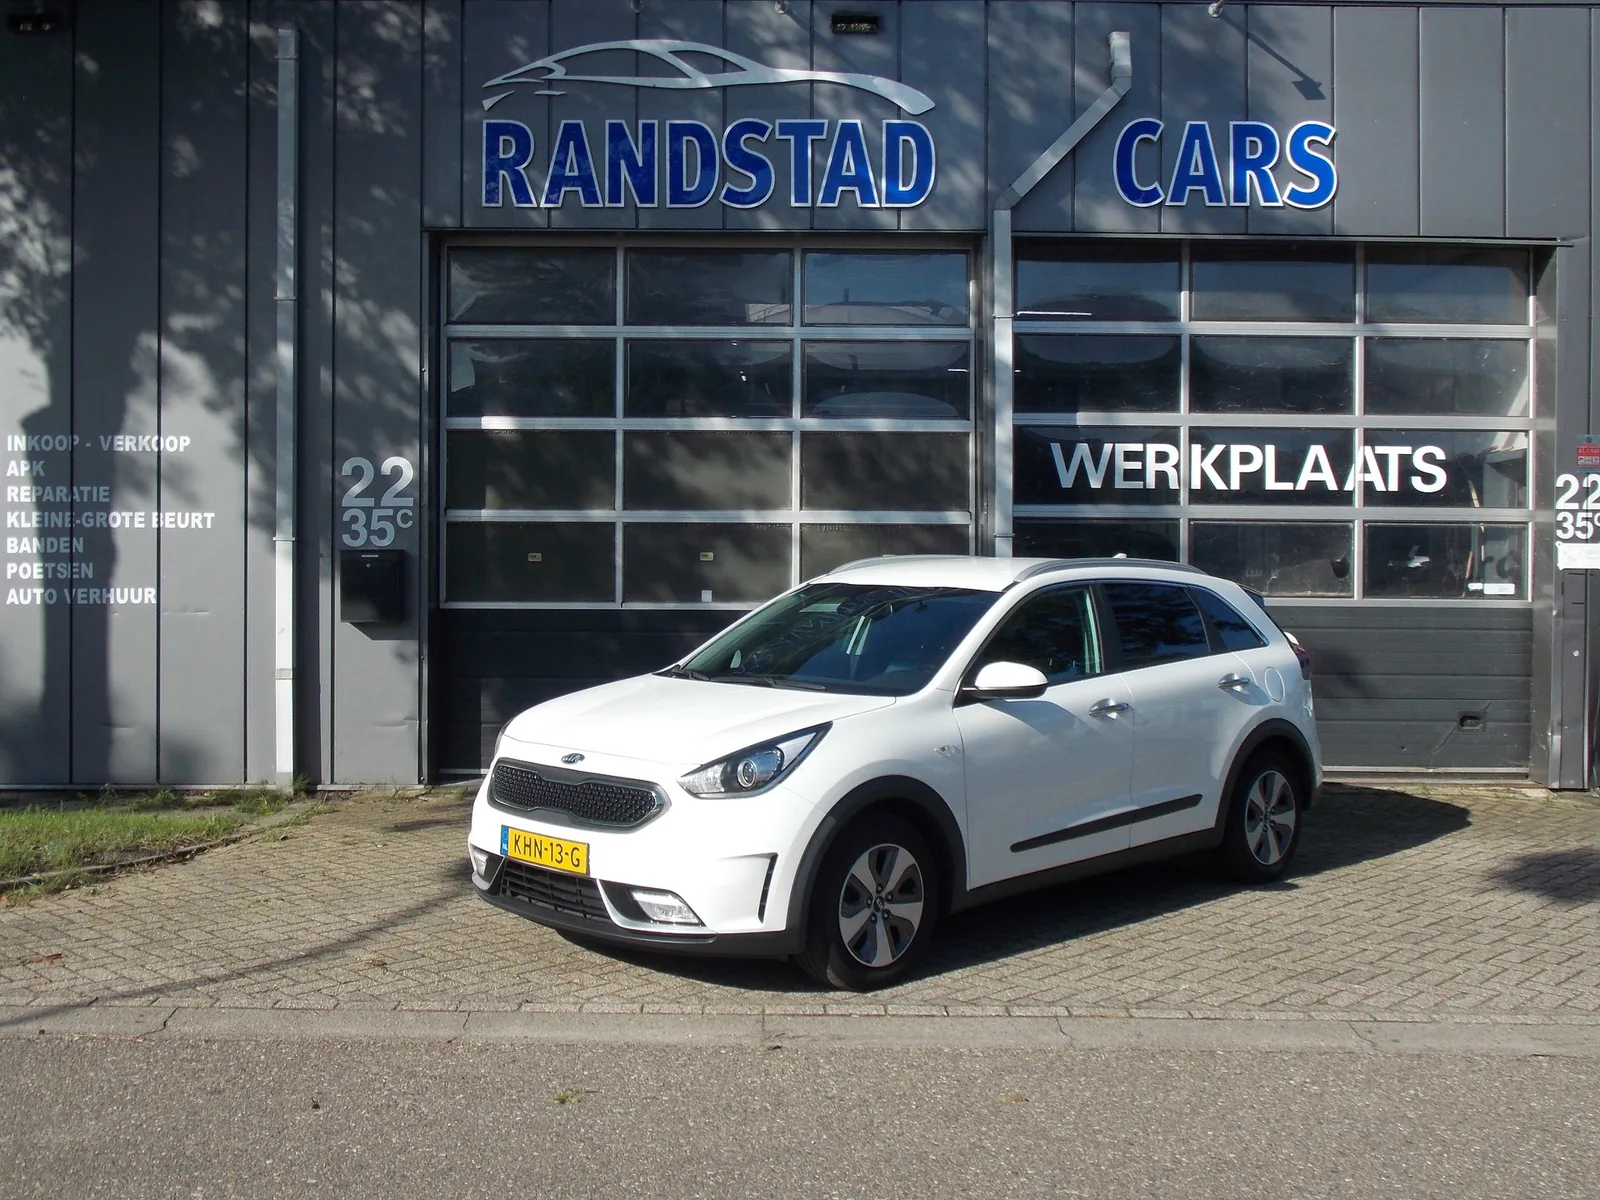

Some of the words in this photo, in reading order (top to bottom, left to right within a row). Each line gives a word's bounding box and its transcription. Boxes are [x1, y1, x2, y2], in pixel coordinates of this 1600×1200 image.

[482, 118, 936, 208] RANDSTAD
[1113, 117, 1337, 209] CARS
[6, 435, 80, 451] INKOOP
[100, 435, 191, 452] VERKOOP
[6, 460, 45, 477] APK
[1050, 442, 1447, 493] WERKPLAATS
[341, 456, 414, 507] 22
[6, 486, 110, 503] REPARATIE
[1555, 473, 1600, 510] 22
[6, 512, 145, 528] KLEINE-GROTE
[152, 512, 215, 529] BEURT
[6, 537, 84, 553] BANDEN
[6, 563, 93, 579] POETSEN
[6, 588, 57, 604] AUTO
[64, 587, 157, 604] VERHUUR
[514, 833, 580, 868] KHN-13-G
